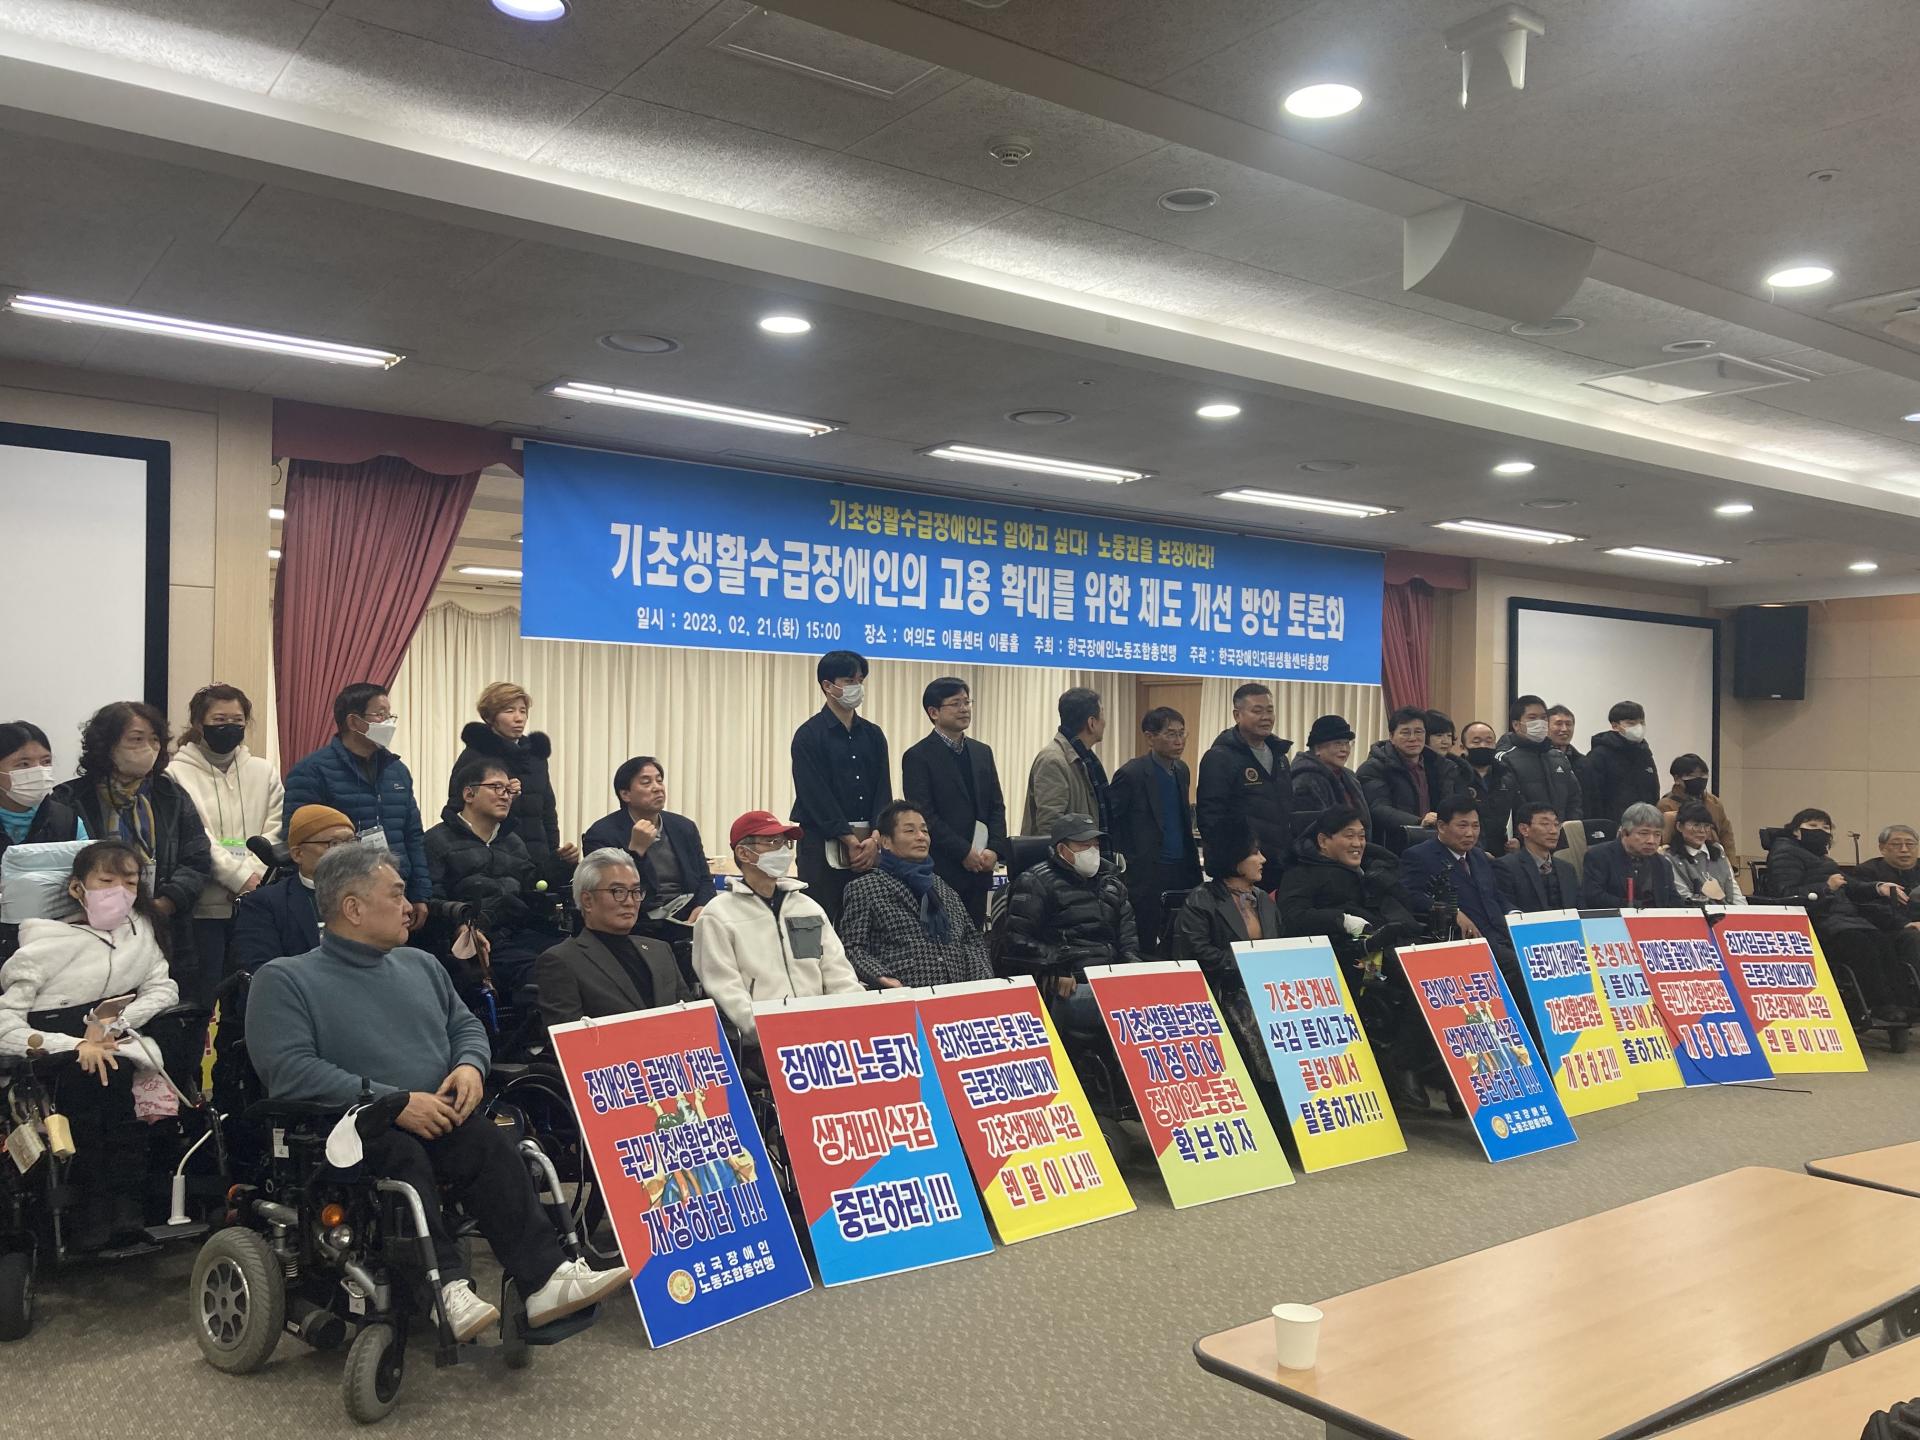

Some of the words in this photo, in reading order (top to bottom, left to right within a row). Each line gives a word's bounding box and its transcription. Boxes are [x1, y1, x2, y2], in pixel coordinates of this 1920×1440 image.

[829, 499, 998, 546] 기초생활수급장애인도
[1004, 520, 1048, 551] 일하고
[1054, 527, 1088, 556] 싶다!
[1098, 532, 1153, 563] 노동권을
[1157, 539, 1215, 569] 보장하라!
[610, 522, 927, 610] 기초생활수급장애인의
[939, 558, 991, 615] 고용
[1001, 564, 1075, 622] 확대를
[1085, 571, 1131, 626] 위한
[1138, 577, 1182, 628] 제도
[1191, 582, 1232, 634] 개선
[1240, 587, 1281, 637] 방안
[1288, 592, 1345, 642] 토론회
[637, 607, 664, 630] 일시
[806, 621, 841, 640] 15:00
[864, 624, 887, 645] 장소
[903, 626, 936, 648] 여의도
[942, 629, 983, 651] 이룸센터
[989, 632, 1020, 653] 이룸홀
[1034, 635, 1054, 655] 주최
[1067, 637, 1177, 662] 한국장애인노동조합총연맹
[1189, 646, 1207, 664] 주관
[1724, 931, 1779, 955] 최저임금도
[1420, 976, 1465, 1008] 장애인
[1461, 972, 1501, 1003] 노동자
[1740, 962, 1817, 987] 근로장애인에게
[1264, 977, 1341, 1013] 기초생계비
[1751, 994, 1810, 1020] 기초생계비
[1806, 995, 1832, 1019] 삭감
[933, 1016, 1007, 1061] 최저임금도
[999, 1015, 1022, 1051] 못
[1015, 1012, 1050, 1047] 받는
[1110, 1001, 1222, 1045] 기초생활보장법
[1269, 1021, 1303, 1053] 삭감
[1494, 1017, 1524, 1047] 삭감
[583, 1061, 650, 1113] 장애인을
[642, 1053, 692, 1100] 골방에
[779, 1040, 855, 1093] 장애인
[855, 1034, 922, 1084] 노동자
[959, 1057, 1059, 1108] 근로장애인에게
[1298, 1053, 1361, 1092] 골방에서
[1147, 1078, 1248, 1126] 장애인노동권
[1469, 1069, 1524, 1105] 중단하라
[616, 1113, 742, 1182] 국민기초생활보장법
[813, 1107, 889, 1164] 생계비
[886, 1102, 937, 1149] 삭감
[979, 1108, 1056, 1157] 기초생계비
[1048, 1103, 1082, 1140] 삭감
[640, 1190, 736, 1255] 개정하라
[832, 1178, 929, 1241] 중단하라
[699, 1255, 776, 1294] 노동조합총연맹
